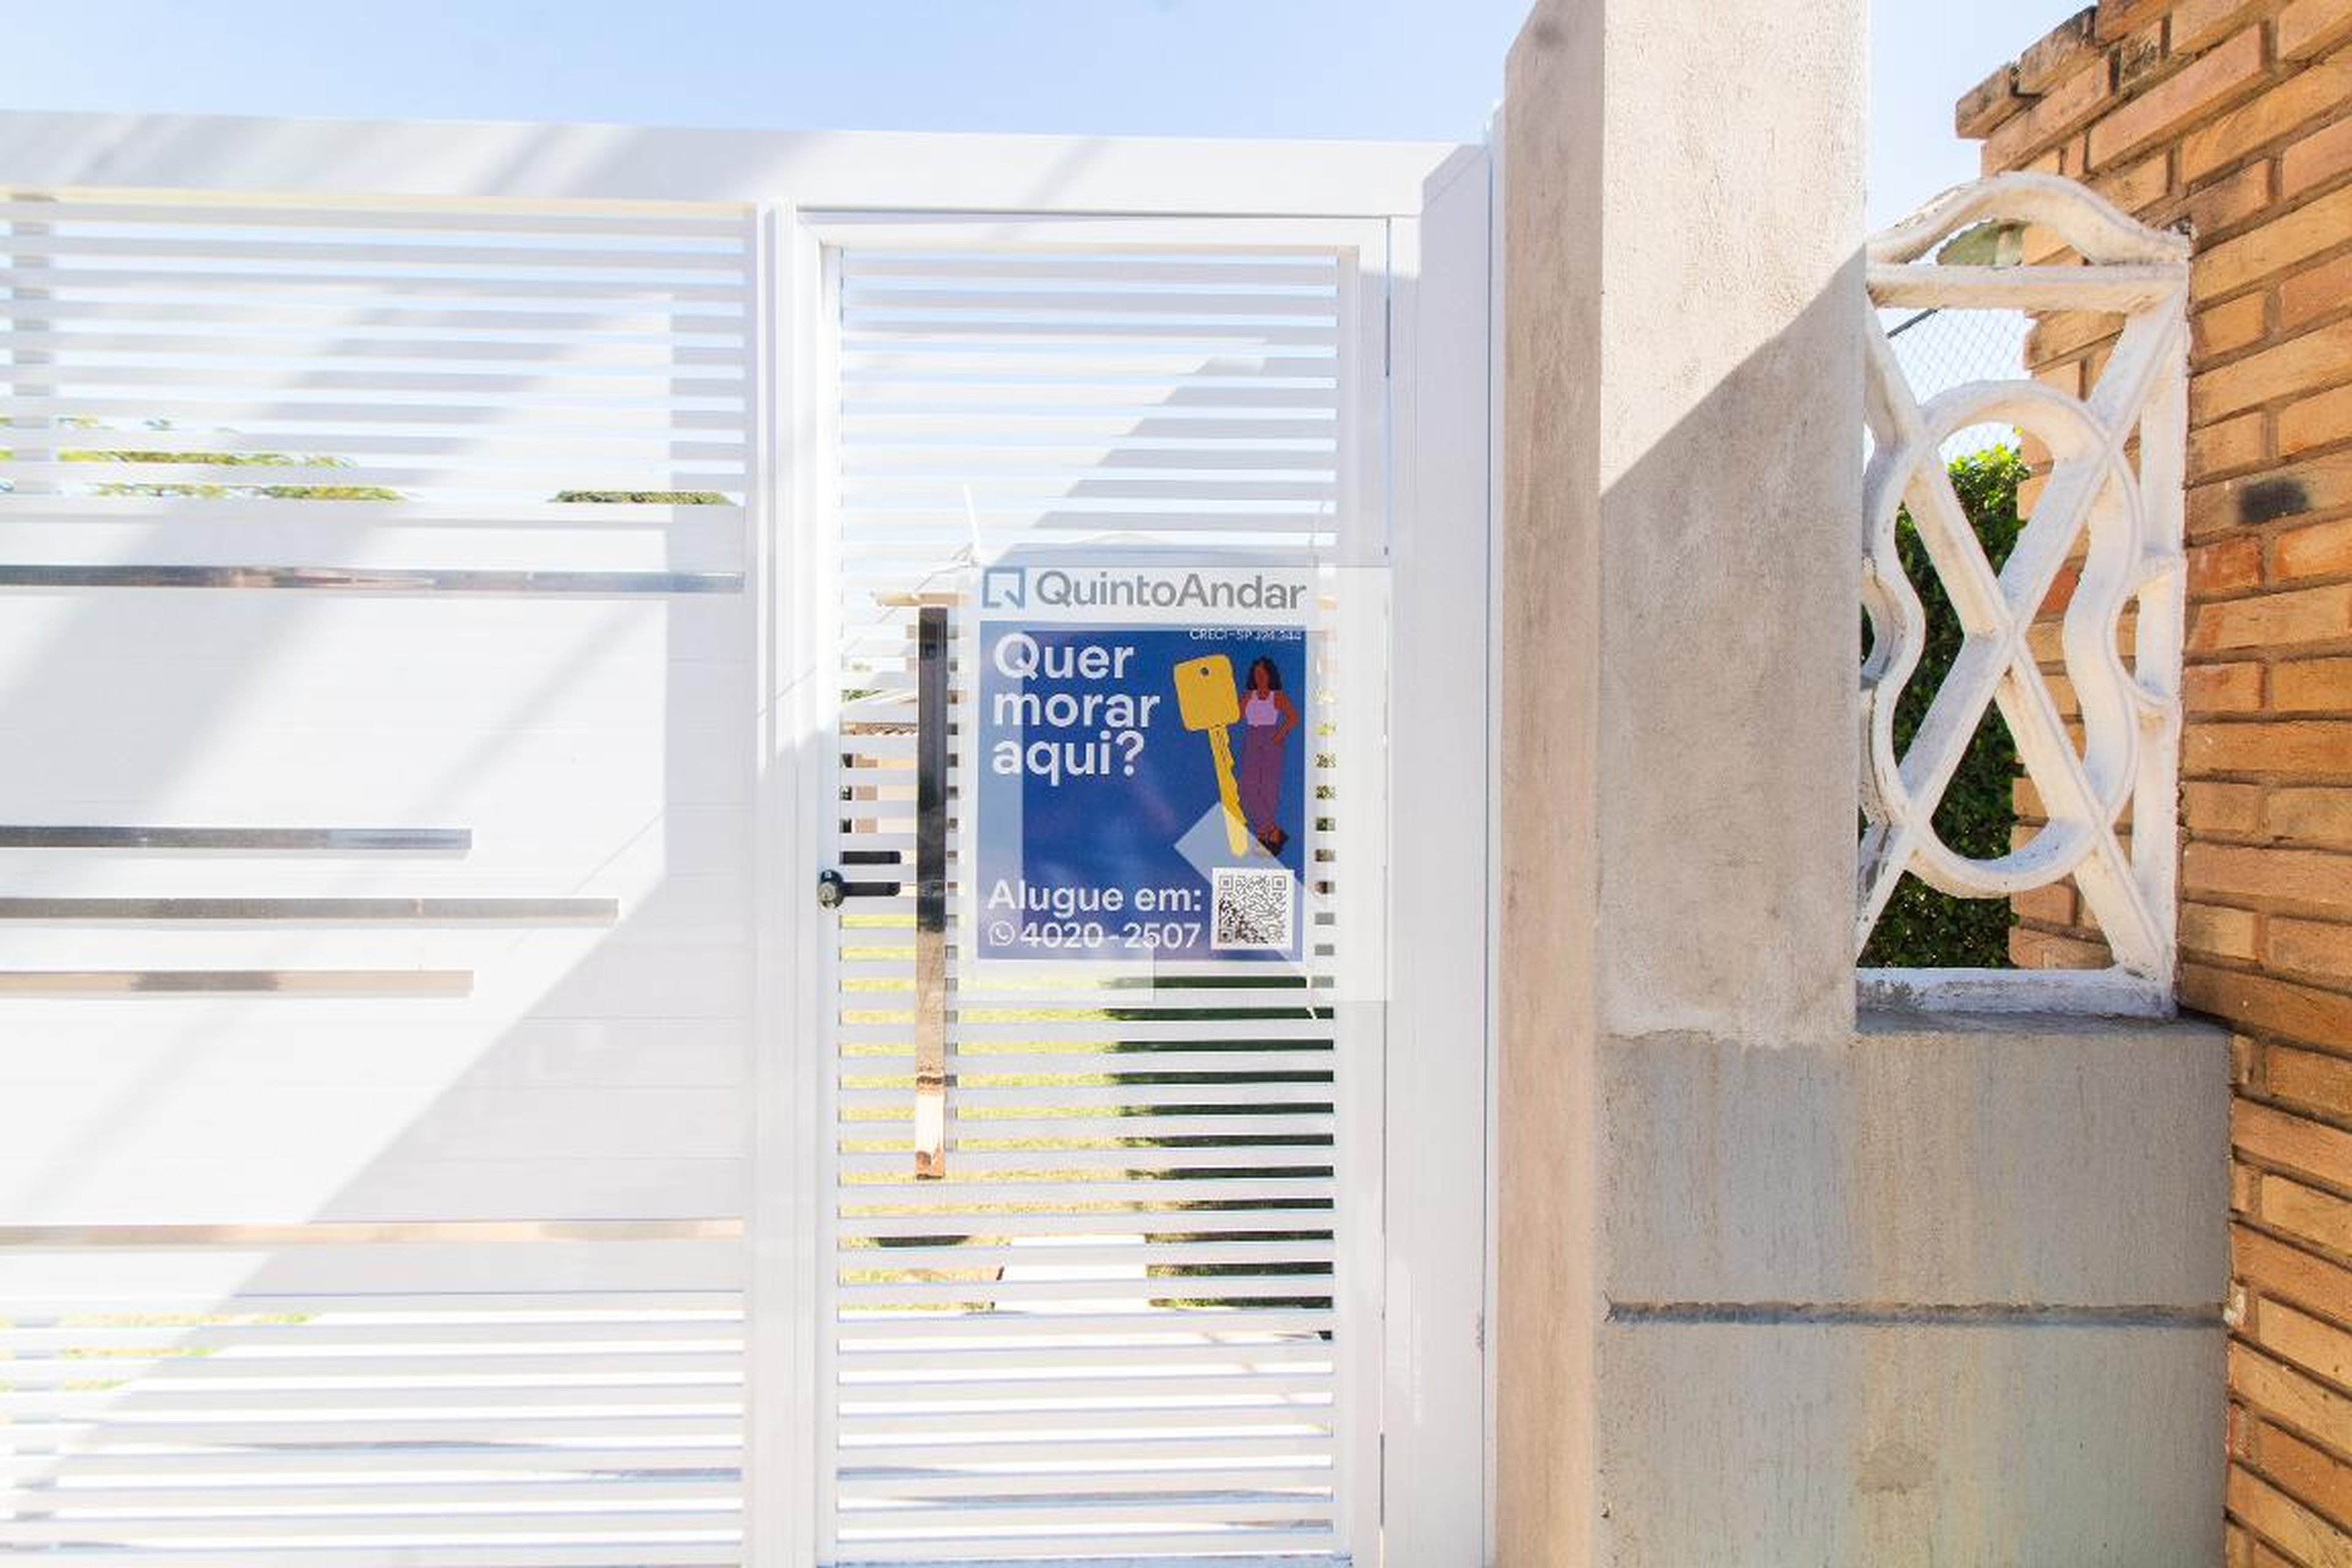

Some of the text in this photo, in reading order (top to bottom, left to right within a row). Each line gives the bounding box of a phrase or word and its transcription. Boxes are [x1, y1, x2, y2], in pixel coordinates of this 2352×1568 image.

[1036, 570, 1306, 609] QuintoAndar
[993, 633, 1134, 680] Quer
[993, 690, 1161, 728] morar
[992, 731, 1145, 786] aqui?
[988, 880, 1201, 919] Alugue em:
[1020, 922, 1201, 949] 4020-2507
